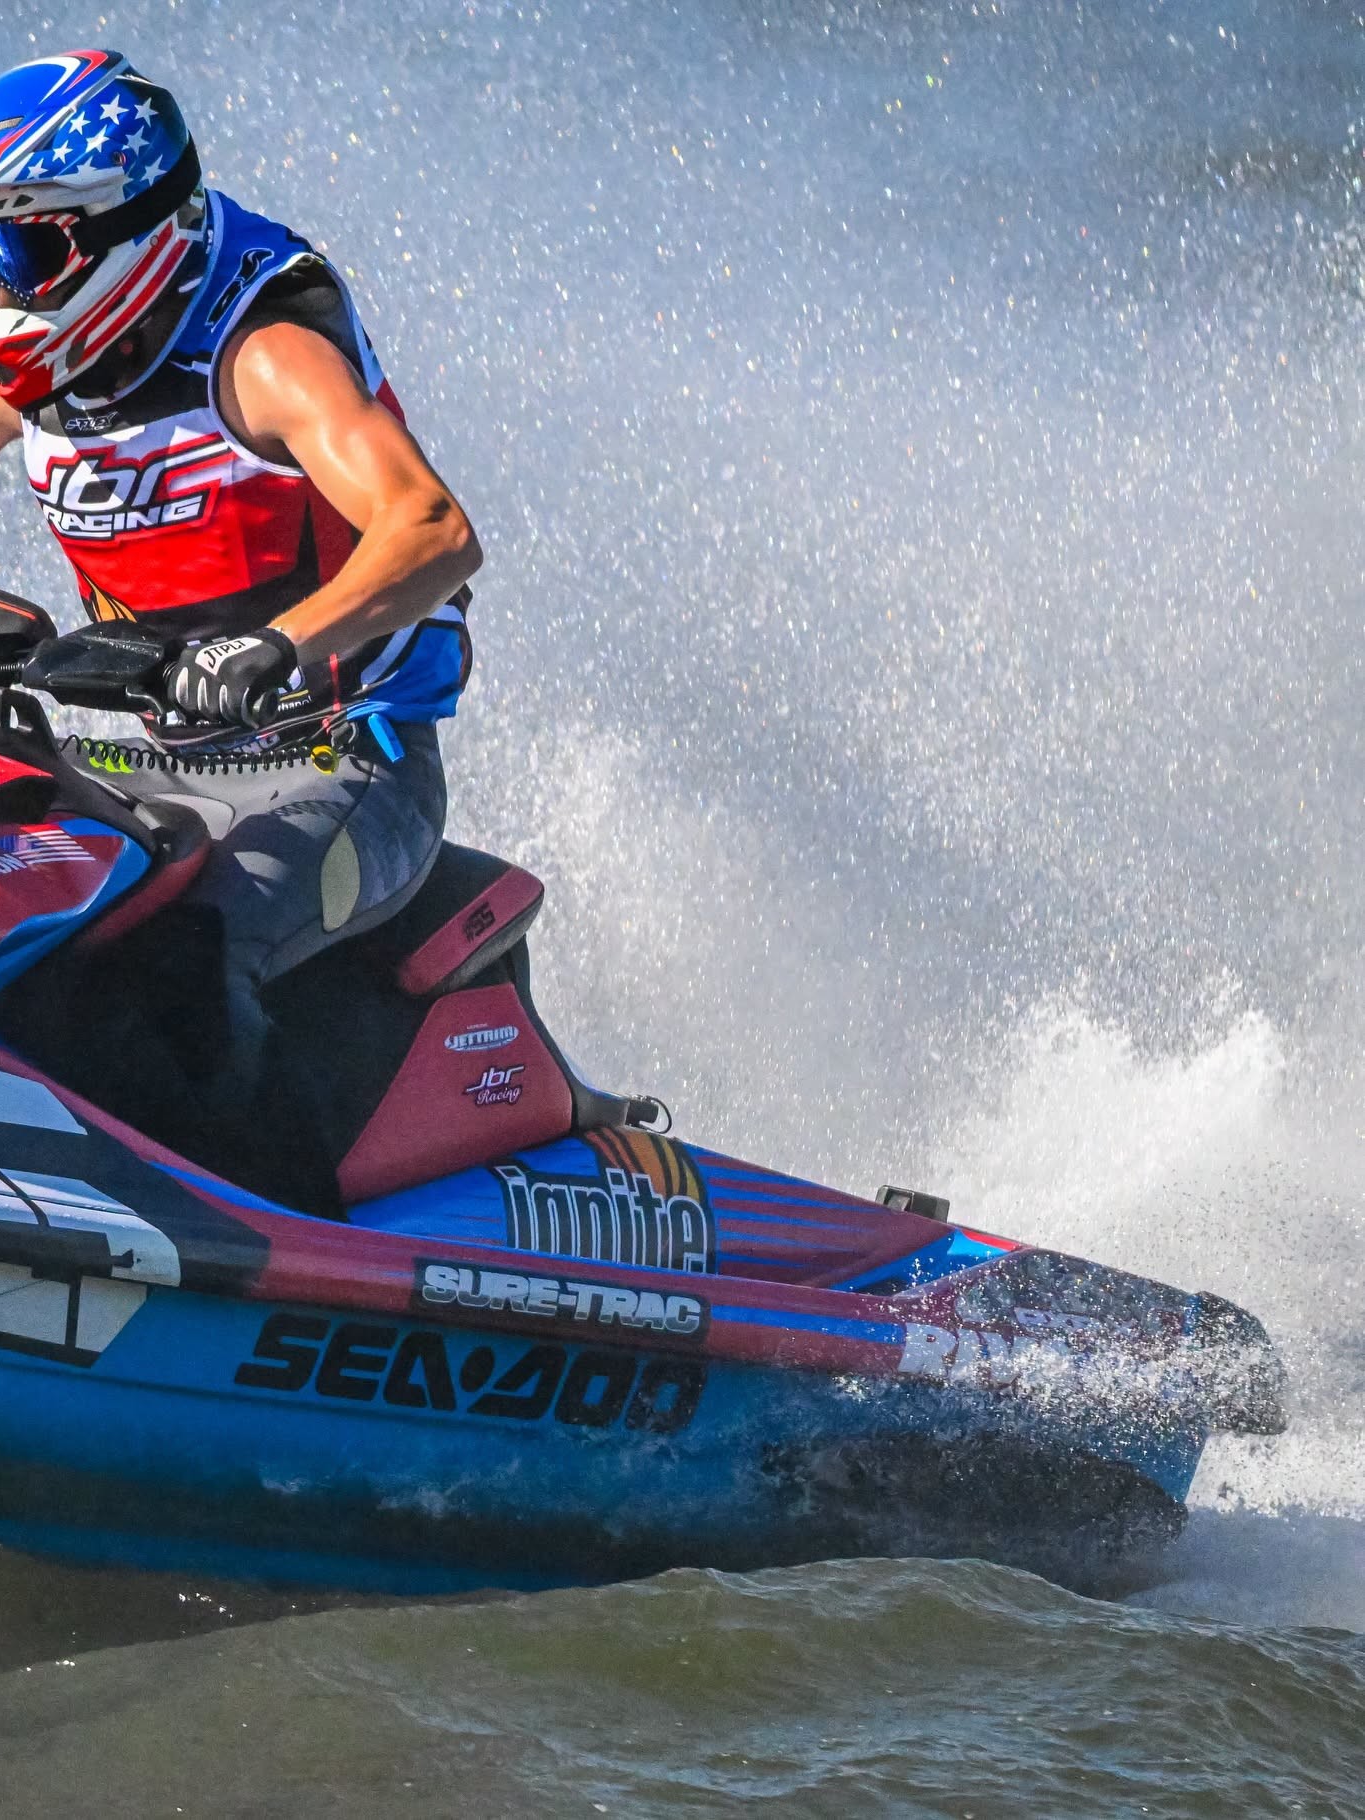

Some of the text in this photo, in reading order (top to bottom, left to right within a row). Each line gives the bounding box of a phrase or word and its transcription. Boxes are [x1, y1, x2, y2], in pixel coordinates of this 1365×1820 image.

[43, 494, 203, 537] RACING
[477, 1087, 521, 1105] Racing
[422, 1264, 701, 1334] SURE-TRAC
